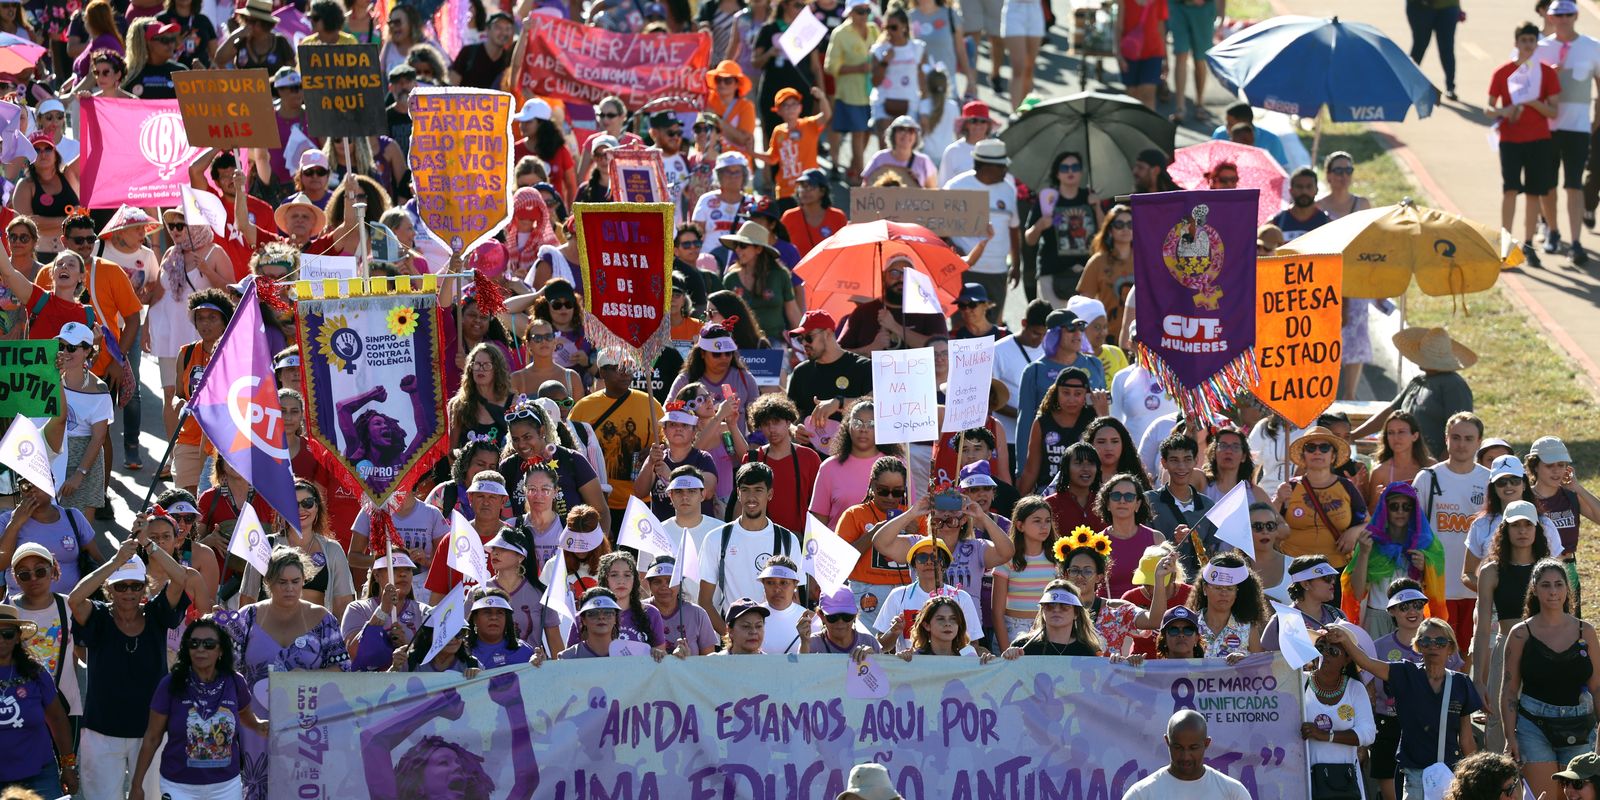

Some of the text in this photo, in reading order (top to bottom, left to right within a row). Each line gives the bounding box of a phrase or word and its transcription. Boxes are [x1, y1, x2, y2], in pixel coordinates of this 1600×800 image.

[310, 53, 370, 68] AINDA
[178, 78, 266, 96] DITADURA
[302, 74, 381, 90] ESTAMOS
[184, 102, 250, 118] NUNCA
[1350, 106, 1384, 120] VISA
[414, 112, 494, 132] TÁRIAS
[464, 135, 502, 152] FIM
[410, 153, 504, 172] DAS VIO-
[415, 170, 502, 192] LÊNCIAS
[419, 194, 503, 212] NO TRA-
[856, 193, 885, 211] NÃO
[428, 213, 488, 232] BALHO
[602, 220, 640, 242] CUT
[602, 252, 649, 269] BASTA
[1284, 262, 1314, 286] EM
[616, 278, 634, 294] DE
[1263, 285, 1340, 314] DEFESA
[602, 298, 656, 320] ASSÉDIO
[1162, 314, 1220, 340] CUT
[1286, 315, 1312, 338] DO
[365, 334, 397, 343] SINPRO
[386, 339, 411, 348] VOCÊ
[1161, 336, 1228, 353] MULHERES
[366, 350, 401, 359] CONTRA
[367, 356, 413, 366] VIOLÊNCIA
[1260, 340, 1342, 368] ESTADO
[889, 382, 907, 393] NA
[1270, 375, 1333, 401] LAICO
[880, 394, 928, 418] LUTA!
[244, 402, 282, 440] PT
[1048, 456, 1063, 464] co
[359, 466, 393, 477] SINPRO
[1436, 503, 1460, 511] BANCO
[1197, 678, 1216, 693] DE
[1219, 676, 1278, 695] MARÇO
[1198, 696, 1278, 710] UNIFICADAS
[715, 694, 846, 744] ESTAMOS
[858, 700, 925, 744] AQUI
[941, 698, 1000, 747] POR
[1216, 712, 1223, 722] E
[1226, 711, 1280, 723] ENTORNO
[688, 750, 924, 800] EDUCAO
